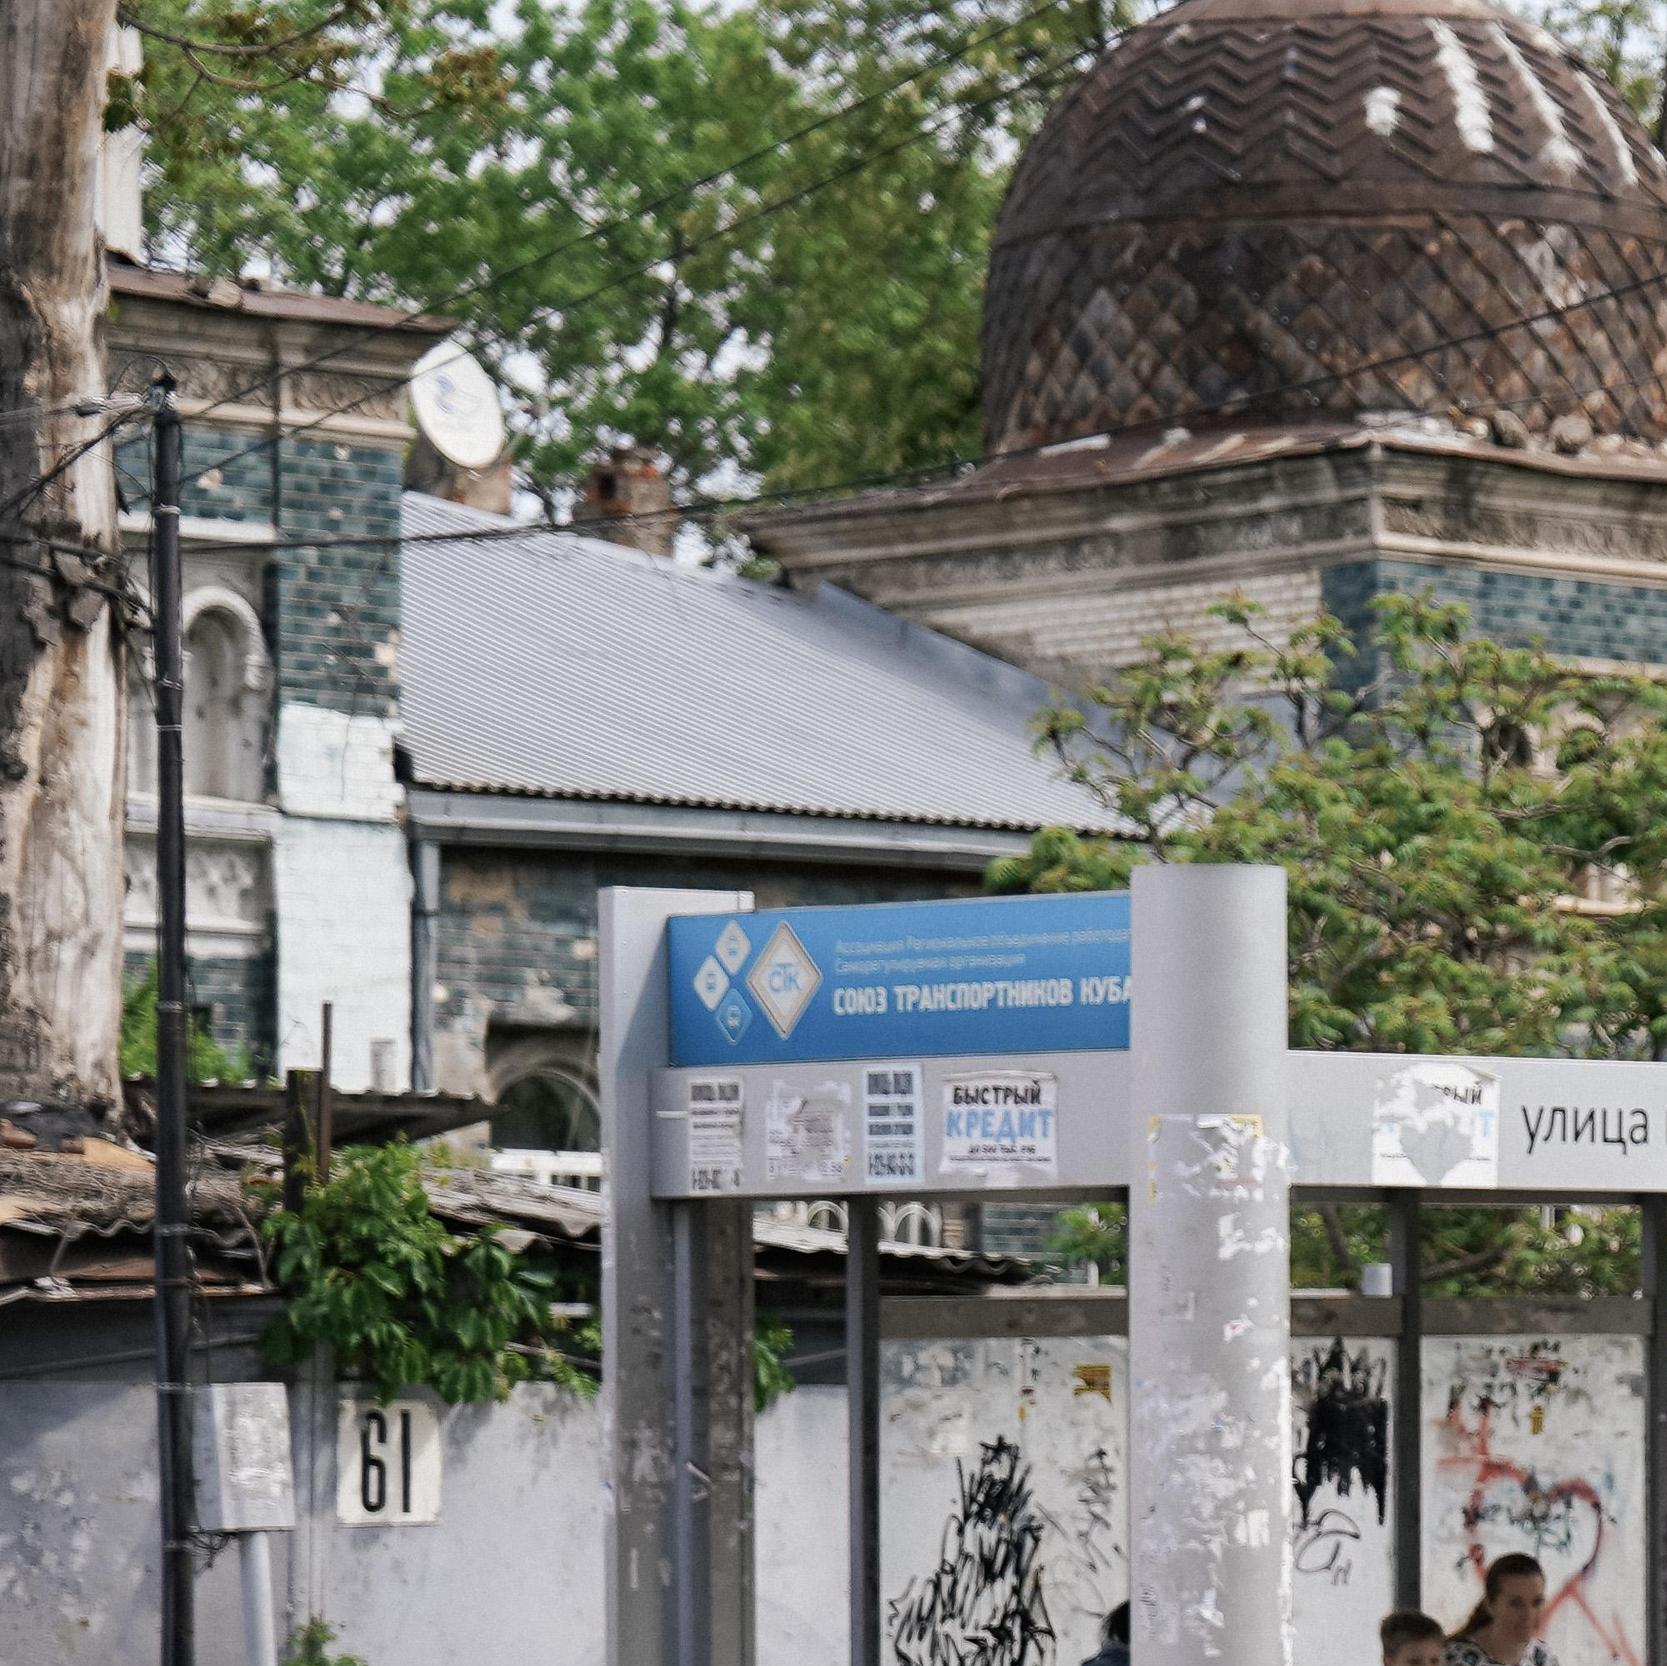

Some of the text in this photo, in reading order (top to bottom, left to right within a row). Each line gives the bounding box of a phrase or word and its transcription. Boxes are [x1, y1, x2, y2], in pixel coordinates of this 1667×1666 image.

[833, 985, 888, 1016] СОЮЗ
[894, 978, 1073, 1013] ТРАНСПОРТНИКОВ
[953, 1079, 1041, 1105] БЫСТРЫЙ
[945, 1108, 1054, 1144] КРЕДИТ
[1521, 1105, 1649, 1155] улица
[361, 1408, 411, 1513] 61
